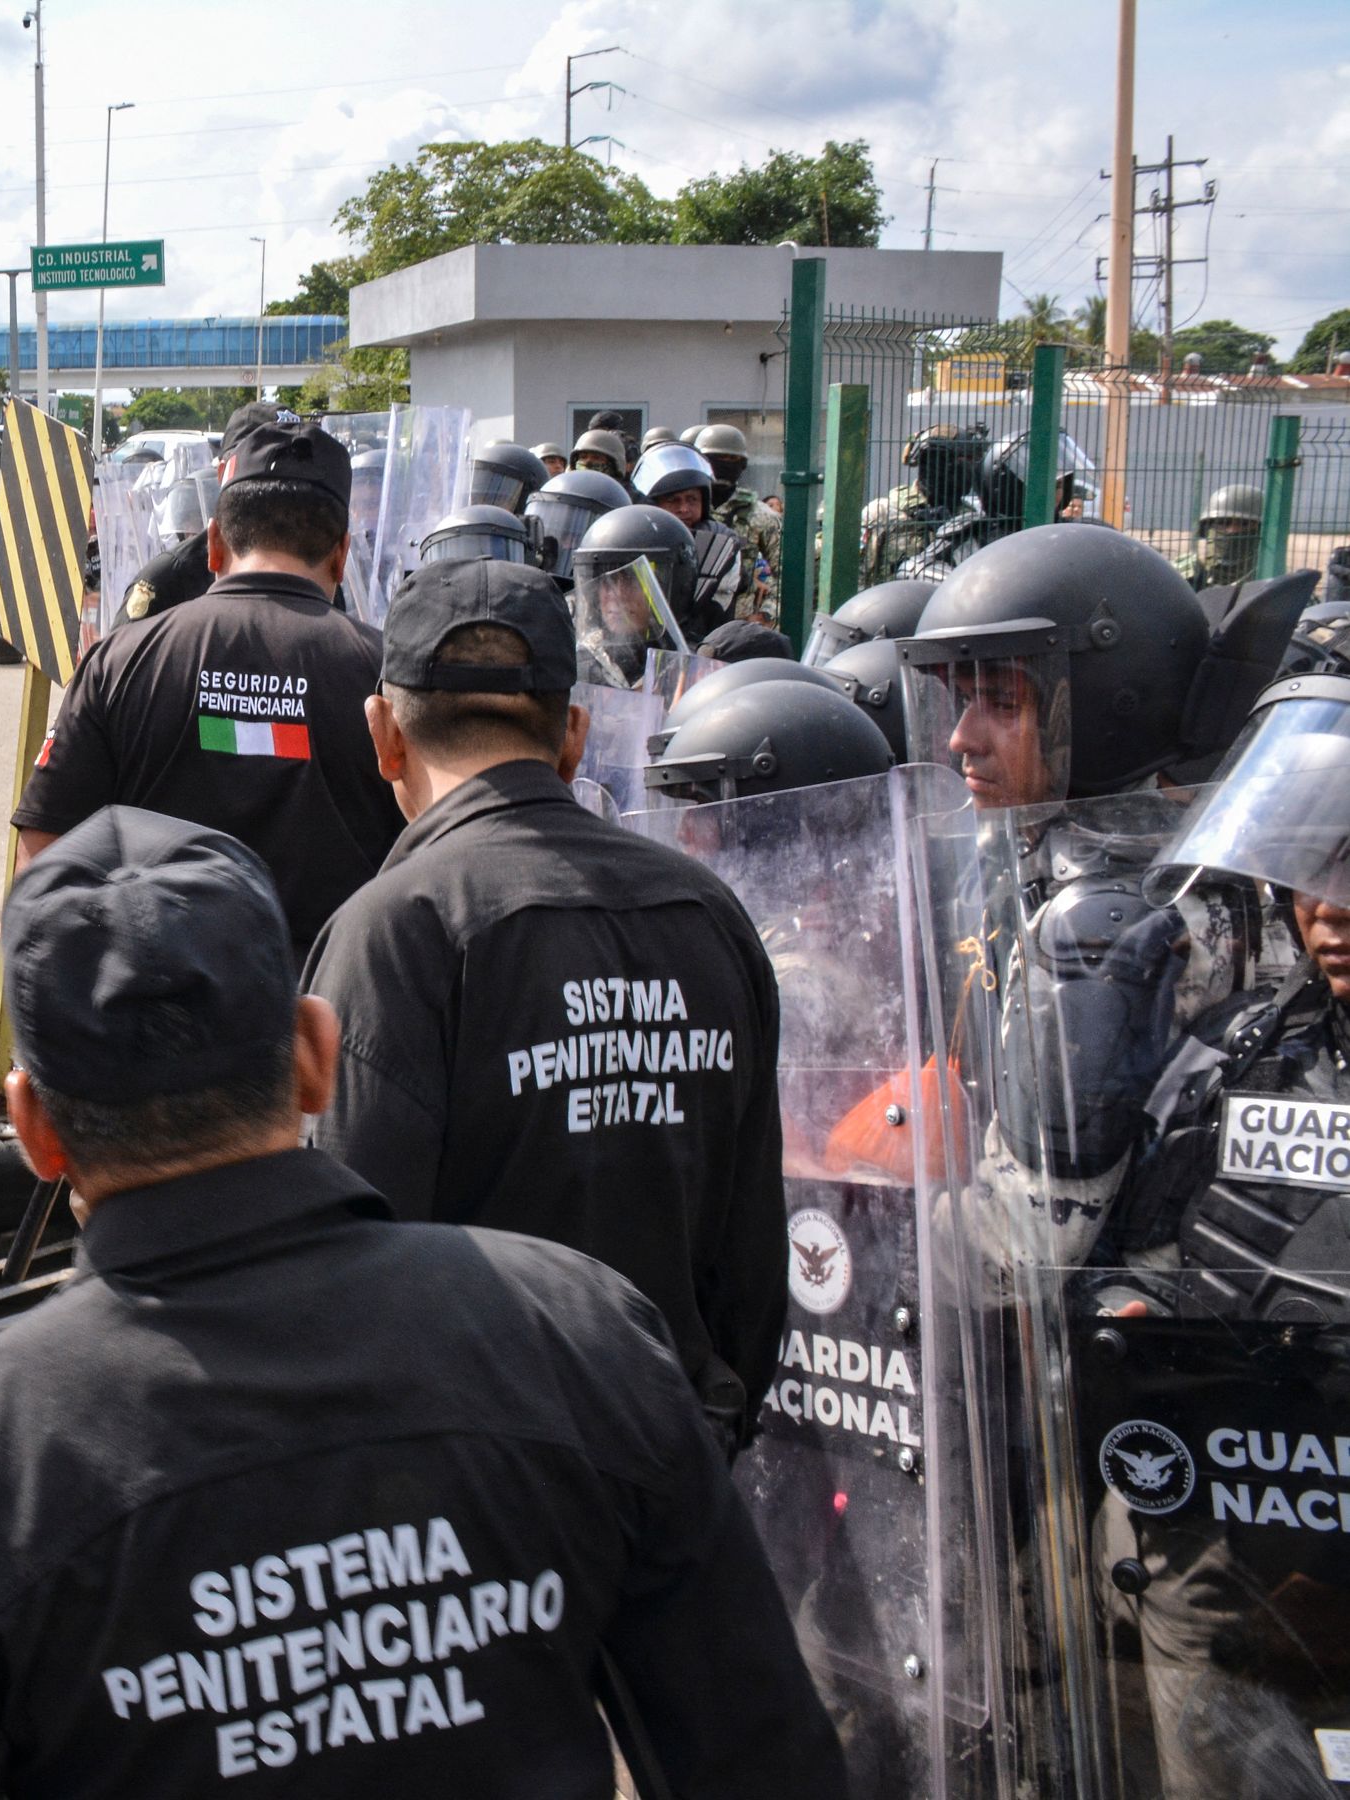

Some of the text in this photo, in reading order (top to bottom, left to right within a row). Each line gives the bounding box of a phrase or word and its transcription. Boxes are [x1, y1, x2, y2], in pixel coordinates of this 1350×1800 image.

[38, 249, 132, 266] CD. INDUSTRIAL
[38, 267, 136, 284] INSTITUTO TECNOLOGICO
[198, 691, 305, 717] PENITENCIARIA
[200, 670, 308, 695] SEGURIDAD
[563, 977, 688, 1026] SISTMA
[568, 1081, 685, 1133] ESTATAL
[778, 1329, 916, 1395] ARDIA
[1106, 1425, 1186, 1463] GUARDIA NACIONAL
[188, 1516, 472, 1637] SISTEMA
[101, 1568, 565, 1722] PENITENCIARIO
[215, 1666, 485, 1779] ESTATAL
